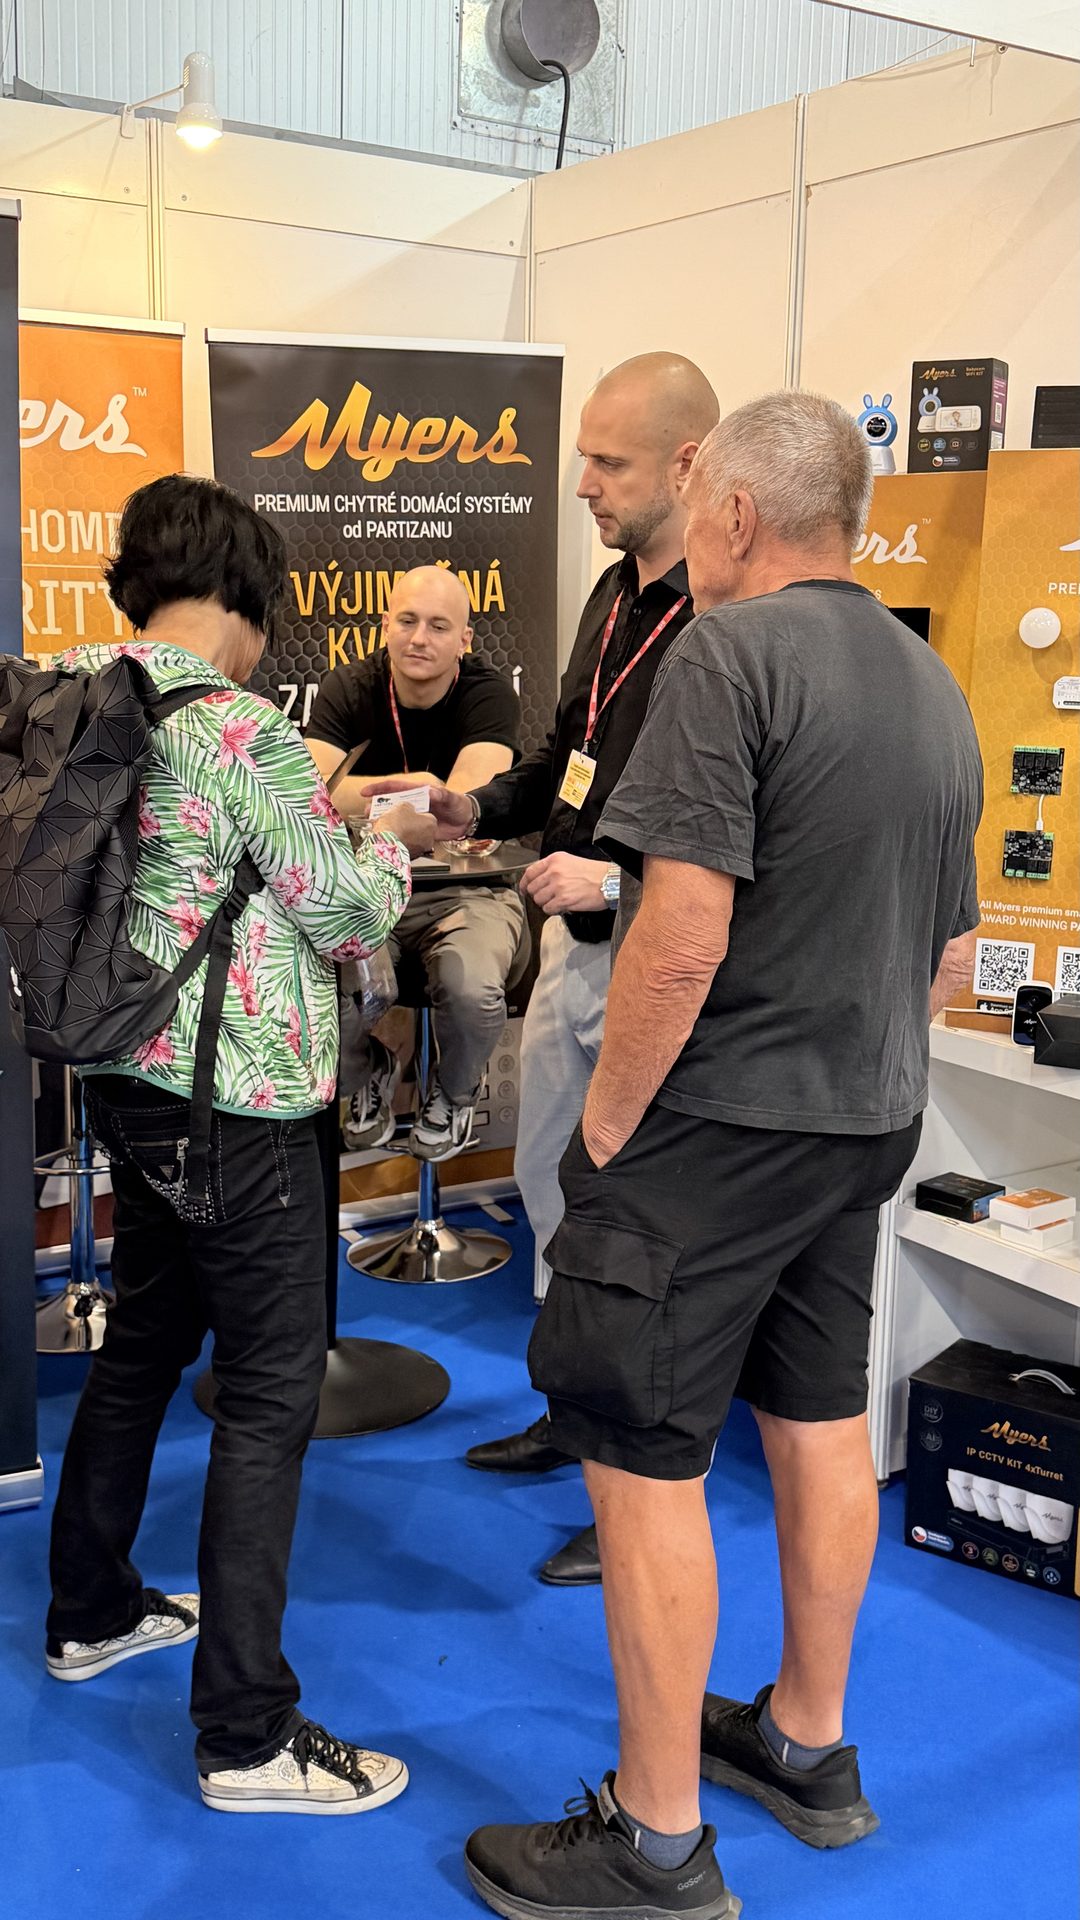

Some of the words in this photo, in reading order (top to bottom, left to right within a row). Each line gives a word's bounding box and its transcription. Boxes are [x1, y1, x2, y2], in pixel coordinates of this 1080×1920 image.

[919, 367, 957, 380] Myers
[251, 381, 532, 482] Myers
[254, 494, 330, 513] PREMIUM
[334, 491, 397, 513] CHYTRÉ
[401, 491, 461, 514] DOMÁCÍ
[464, 493, 533, 514] SYSTÉMY
[343, 520, 362, 538] od
[366, 520, 453, 538] PARTIZANU
[290, 558, 506, 616] VÝJIMNÁ
[979, 900, 991, 909] All
[993, 901, 1021, 912] Myers
[1022, 904, 1063, 916] premium
[980, 913, 1017, 925] AWARD
[1019, 916, 1067, 931] WINNING
[980, 1420, 1051, 1451] Myers
[966, 1446, 977, 1456] IP
[978, 1450, 1005, 1464] CCTV
[1007, 1457, 1023, 1470] KIT
[1025, 1463, 1064, 1482] 4xTurret
